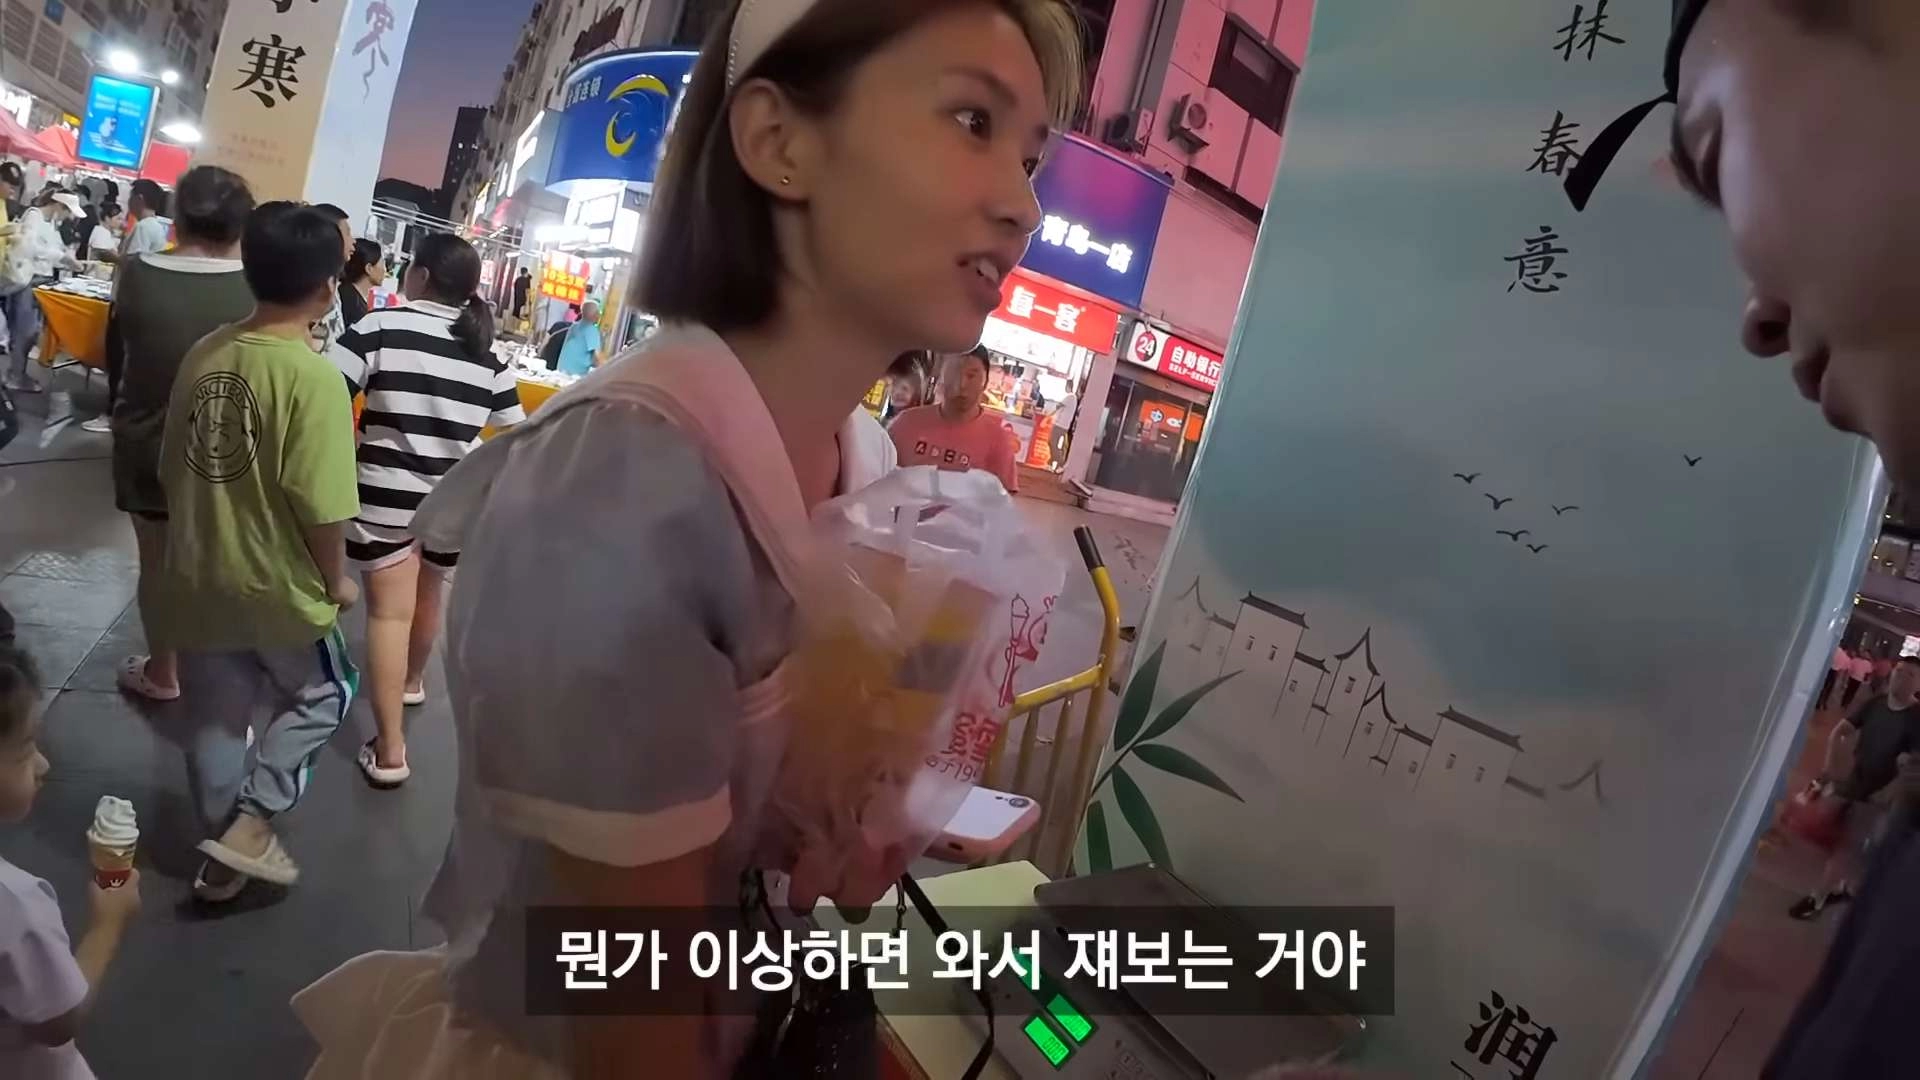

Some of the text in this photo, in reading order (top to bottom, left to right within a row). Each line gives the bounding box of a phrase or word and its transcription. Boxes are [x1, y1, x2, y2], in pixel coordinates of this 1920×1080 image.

[1137, 337, 1156, 356] 24
[1170, 345, 1222, 379] 自助银行
[1450, 989, 1558, 1080] 润
